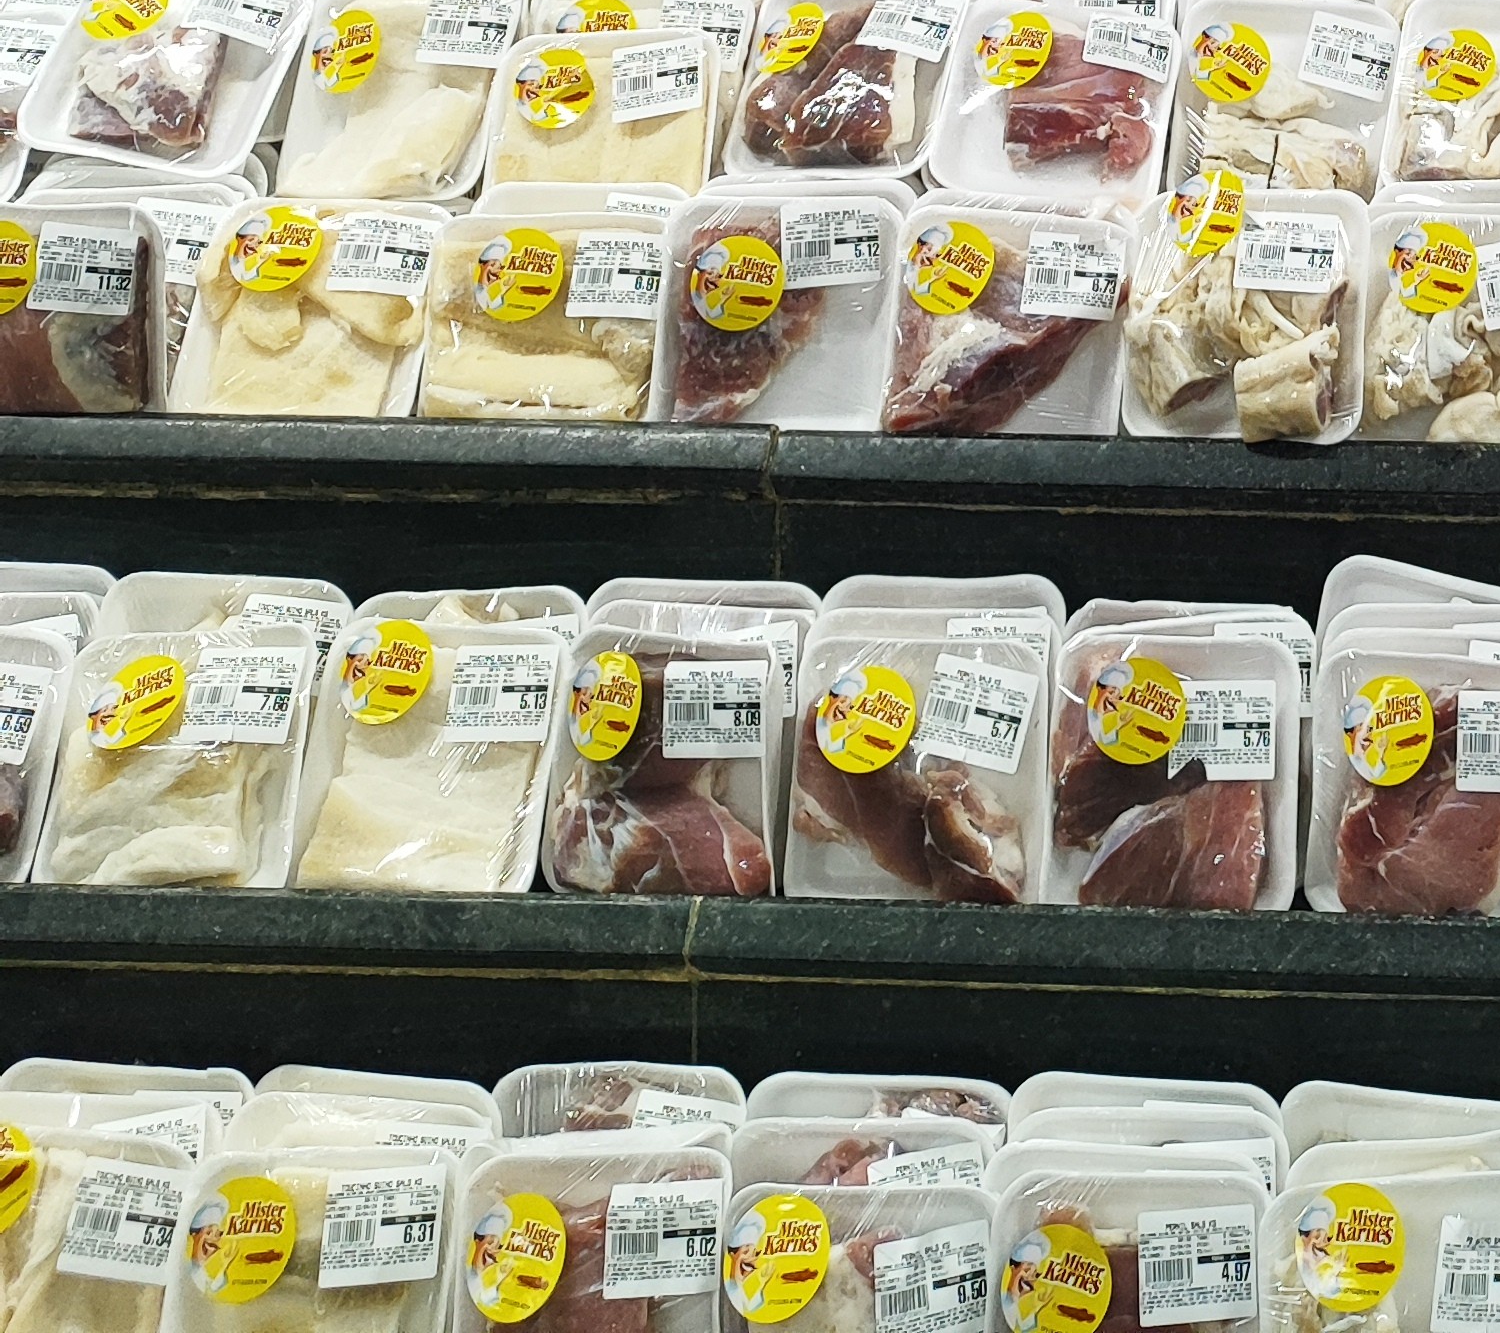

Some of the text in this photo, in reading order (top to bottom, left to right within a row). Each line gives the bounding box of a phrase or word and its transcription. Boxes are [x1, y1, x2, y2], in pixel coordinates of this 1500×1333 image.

[596, 11, 629, 22] Mister
[336, 33, 372, 52] Karnes
[1006, 35, 1043, 49] Karnes
[1021, 27, 1047, 40] Mister
[1223, 45, 1262, 75] Karnes
[1240, 43, 1267, 66] Mister
[1447, 48, 1486, 72] Karnes
[1461, 43, 1491, 63] Mister
[265, 231, 313, 247] Karnes
[282, 223, 317, 236] Mister
[523, 247, 557, 262] Mister
[943, 246, 985, 279] Karnes
[959, 243, 990, 267] Mister
[1422, 247, 1469, 274] Karnes
[1439, 242, 1472, 262] Mister
[507, 255, 554, 274] Karnes
[725, 264, 774, 286] Karnes
[741, 256, 777, 273] Mister
[98, 276, 131, 291] 11,32
[392, 640, 427, 659] Mister
[373, 650, 420, 674] Karnes
[136, 666, 174, 687] Mister
[122, 678, 173, 706] Karnes
[520, 693, 546, 710] 5,13
[876, 691, 910, 714] Mister
[1145, 681, 1181, 707] Mister
[857, 696, 905, 728] Karnes
[1127, 687, 1177, 721] Karnes
[1386, 694, 1421, 712] Mister
[733, 711, 761, 727] 8,09
[1376, 704, 1421, 730] Karnes
[990, 720, 1018, 742] 5,71
[243, 1201, 286, 1217] Mister
[1351, 1209, 1393, 1228] Mister
[226, 1214, 283, 1235] Karnes
[404, 1222, 434, 1244] 6,31
[525, 1221, 560, 1243] Mister
[779, 1221, 821, 1235] Mister
[1335, 1222, 1393, 1245] Karnes
[143, 1224, 173, 1248] 5,34
[505, 1231, 557, 1261] Karnes
[686, 1236, 716, 1257] 6,02
[764, 1234, 818, 1255] Karnes
[1043, 1260, 1101, 1294] Karnes
[1063, 1253, 1105, 1280] Mister
[1222, 1261, 1250, 1281] 4,97
